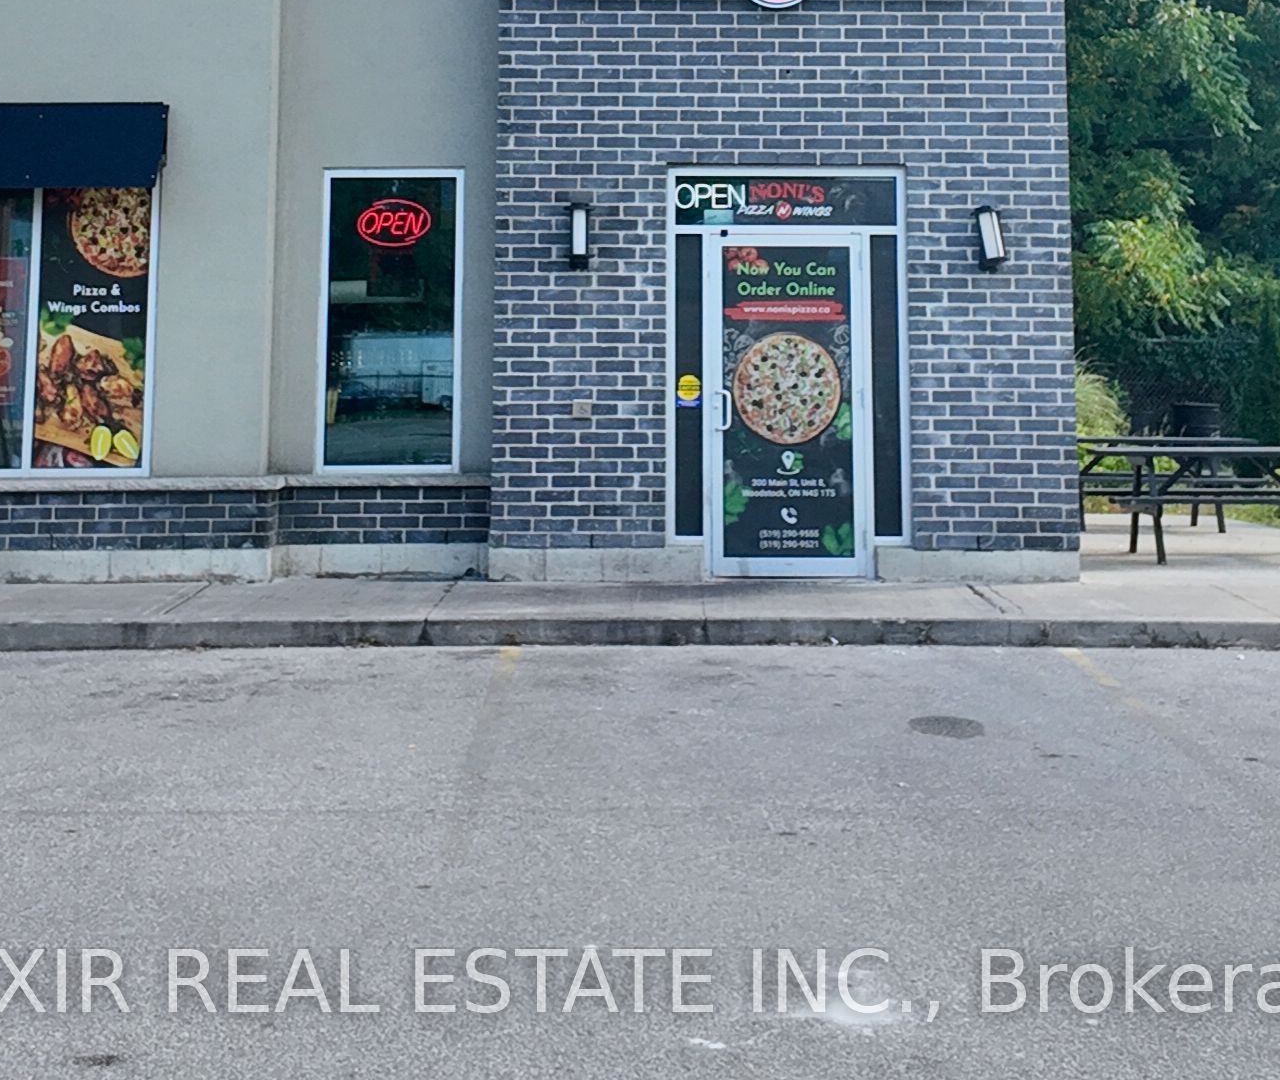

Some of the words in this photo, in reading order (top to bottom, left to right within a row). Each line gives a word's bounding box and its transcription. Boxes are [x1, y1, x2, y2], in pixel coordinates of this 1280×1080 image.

[675, 183, 746, 209] OPEN
[749, 182, 825, 204] NONI'S
[736, 204, 776, 216] PIZZA
[792, 205, 834, 217] WINGS
[361, 212, 425, 235] OPEN
[736, 262, 770, 275] Now
[774, 262, 802, 275] You
[806, 262, 836, 275] Can
[73, 283, 107, 296] Pizza
[110, 283, 121, 296] &
[737, 281, 782, 296] Order
[786, 281, 836, 296] Online
[47, 301, 87, 316] Wings
[91, 300, 140, 313] Combos
[787, 489, 801, 497] ON
